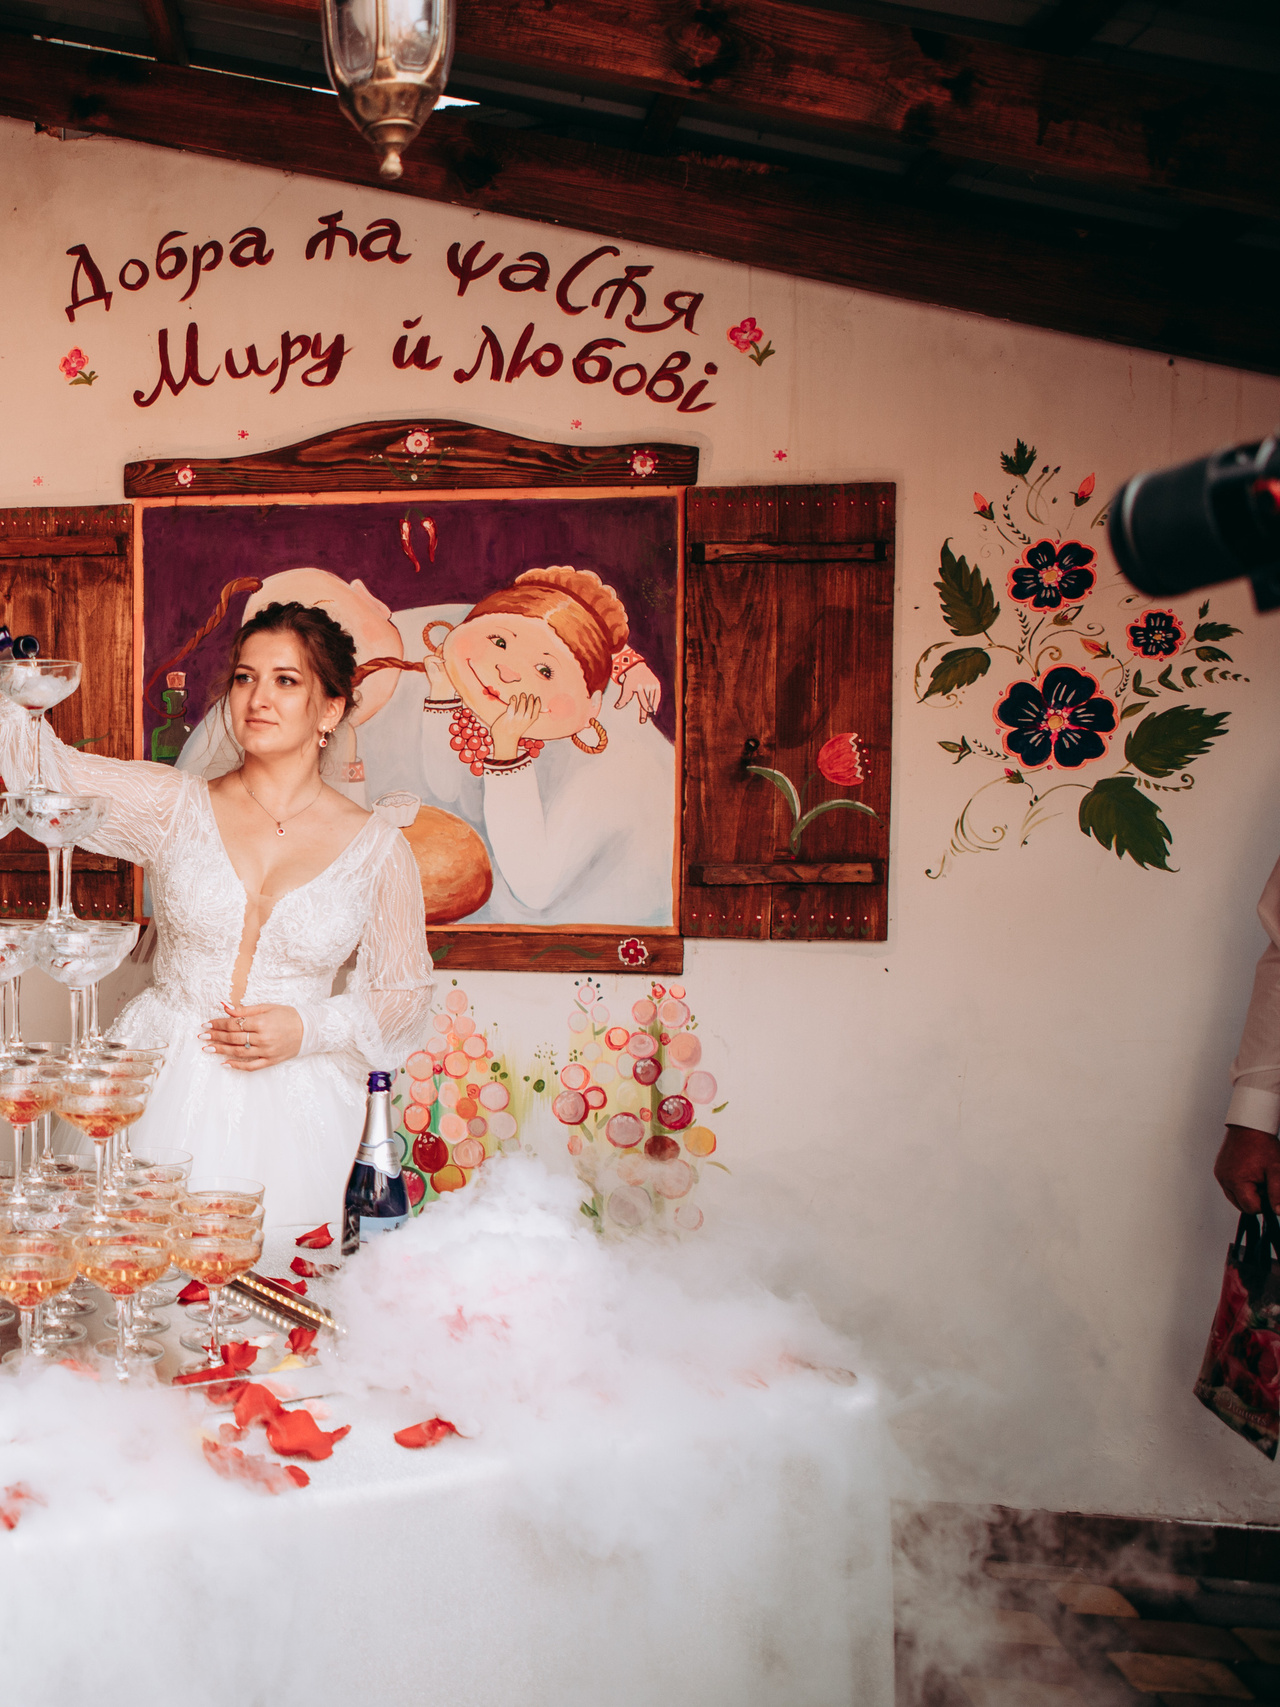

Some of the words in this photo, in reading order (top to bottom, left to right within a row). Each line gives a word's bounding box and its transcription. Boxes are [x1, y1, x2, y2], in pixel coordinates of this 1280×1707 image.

[64, 225, 276, 323] Добра
[305, 209, 414, 266] та
[132, 322, 353, 408] Миру
[392, 315, 443, 371] й
[453, 322, 720, 414] Любові
